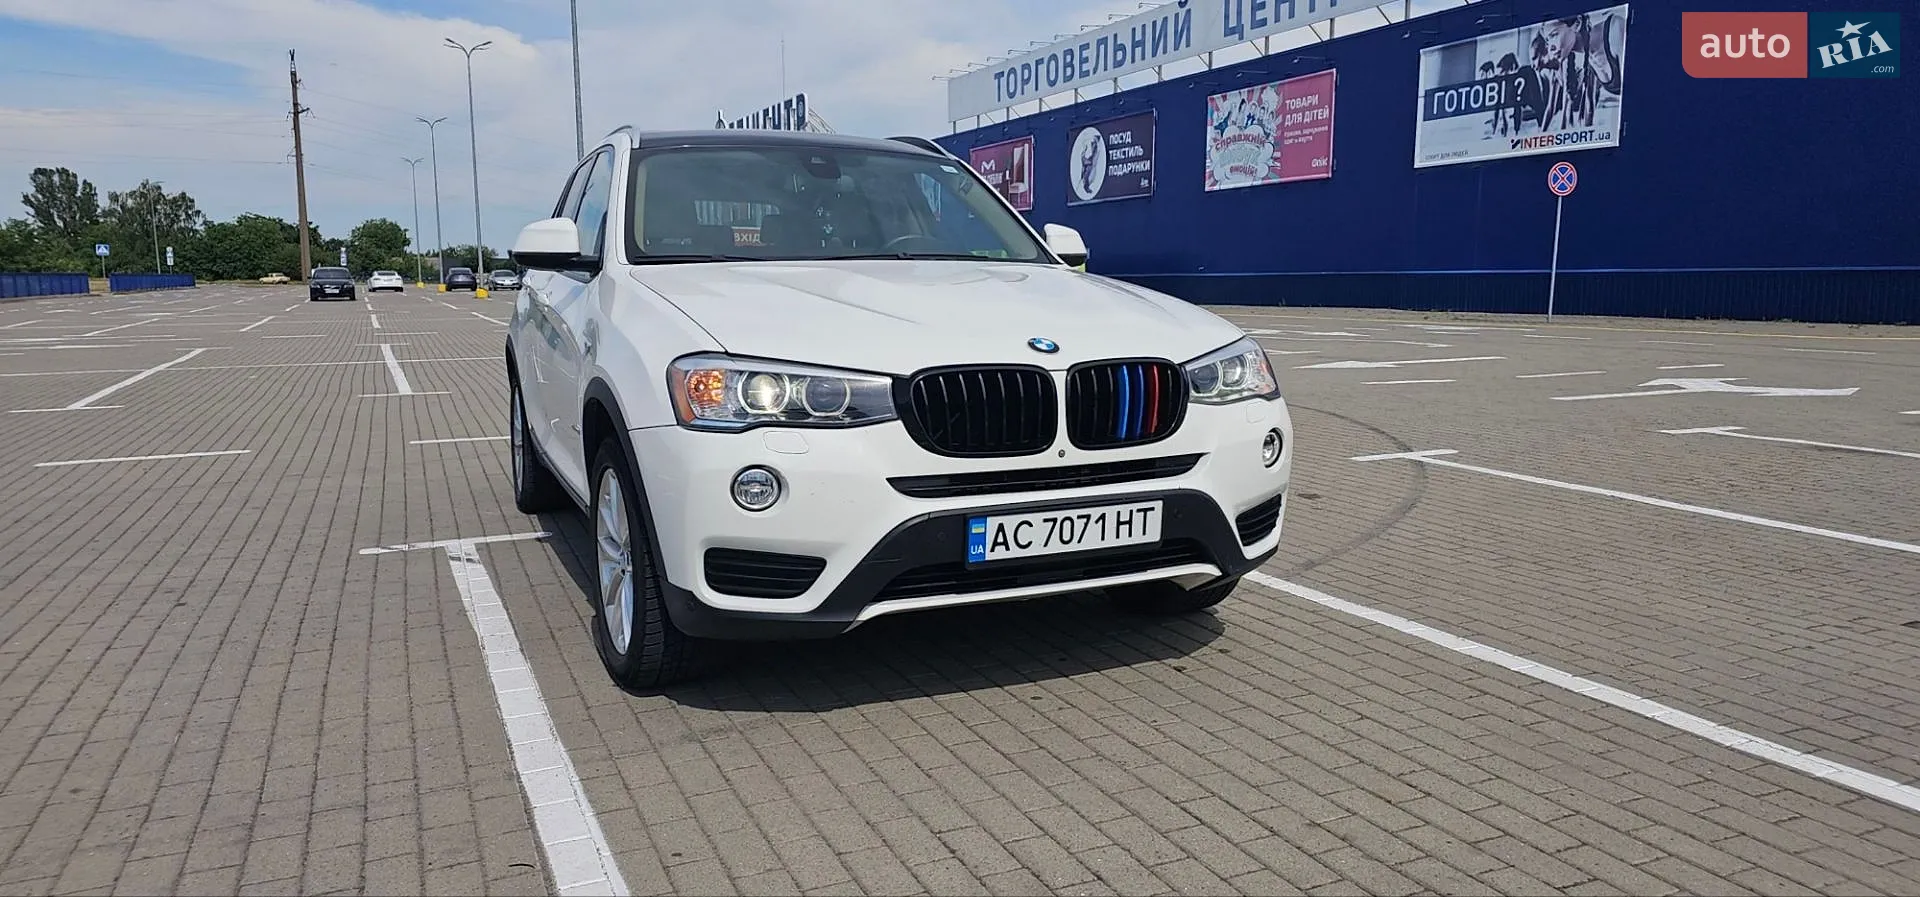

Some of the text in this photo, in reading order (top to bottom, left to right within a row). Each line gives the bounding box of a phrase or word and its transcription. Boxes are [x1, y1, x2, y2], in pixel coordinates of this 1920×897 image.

[994, 0, 1192, 102] ТОРГОВЕЛЬНИЙ
[1285, 94, 1319, 111] ТОВАРИ
[1433, 80, 1506, 115] ГОТОВІ
[1284, 105, 1330, 128] ДЛЯ ДІТЕЙ
[1109, 131, 1132, 145] ПОСУД
[1520, 129, 1611, 149] INTERSPORT.ua
[1108, 145, 1144, 160] ТЕКСТИЛЬ
[1108, 160, 1151, 177] ПОДАРУНКИ
[734, 233, 761, 243] ВХІД
[989, 506, 1156, 553] AC 7071 HT
[970, 544, 985, 555] UA
